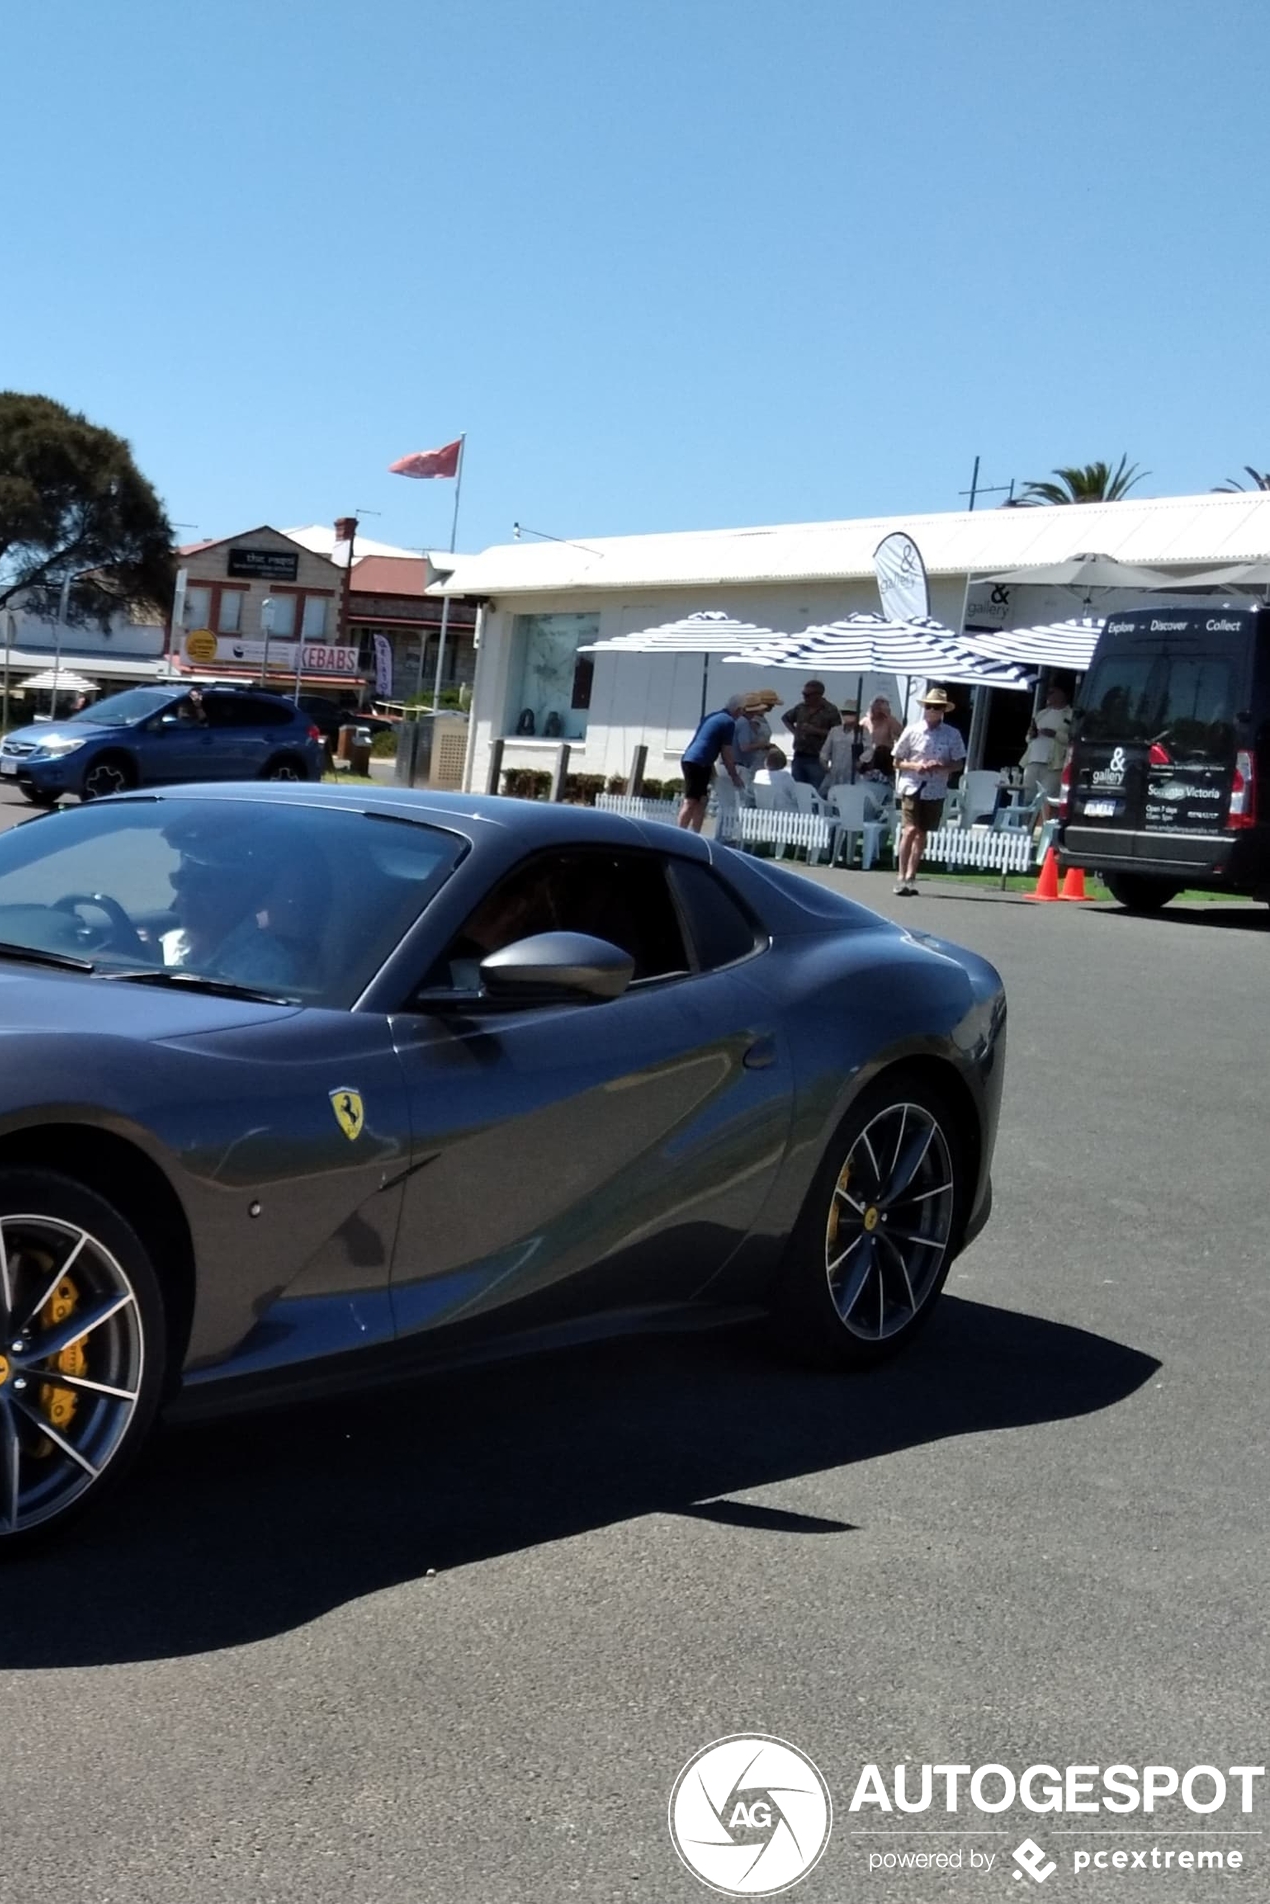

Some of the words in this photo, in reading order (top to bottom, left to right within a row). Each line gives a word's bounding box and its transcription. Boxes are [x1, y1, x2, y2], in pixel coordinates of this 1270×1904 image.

[968, 603, 1009, 619] gallery
[1108, 622, 1135, 635] Explore
[1150, 620, 1188, 631] Discover
[1206, 619, 1241, 631] Collect
[1093, 769, 1124, 785] gallery
[1186, 787, 1220, 799] Victoria
